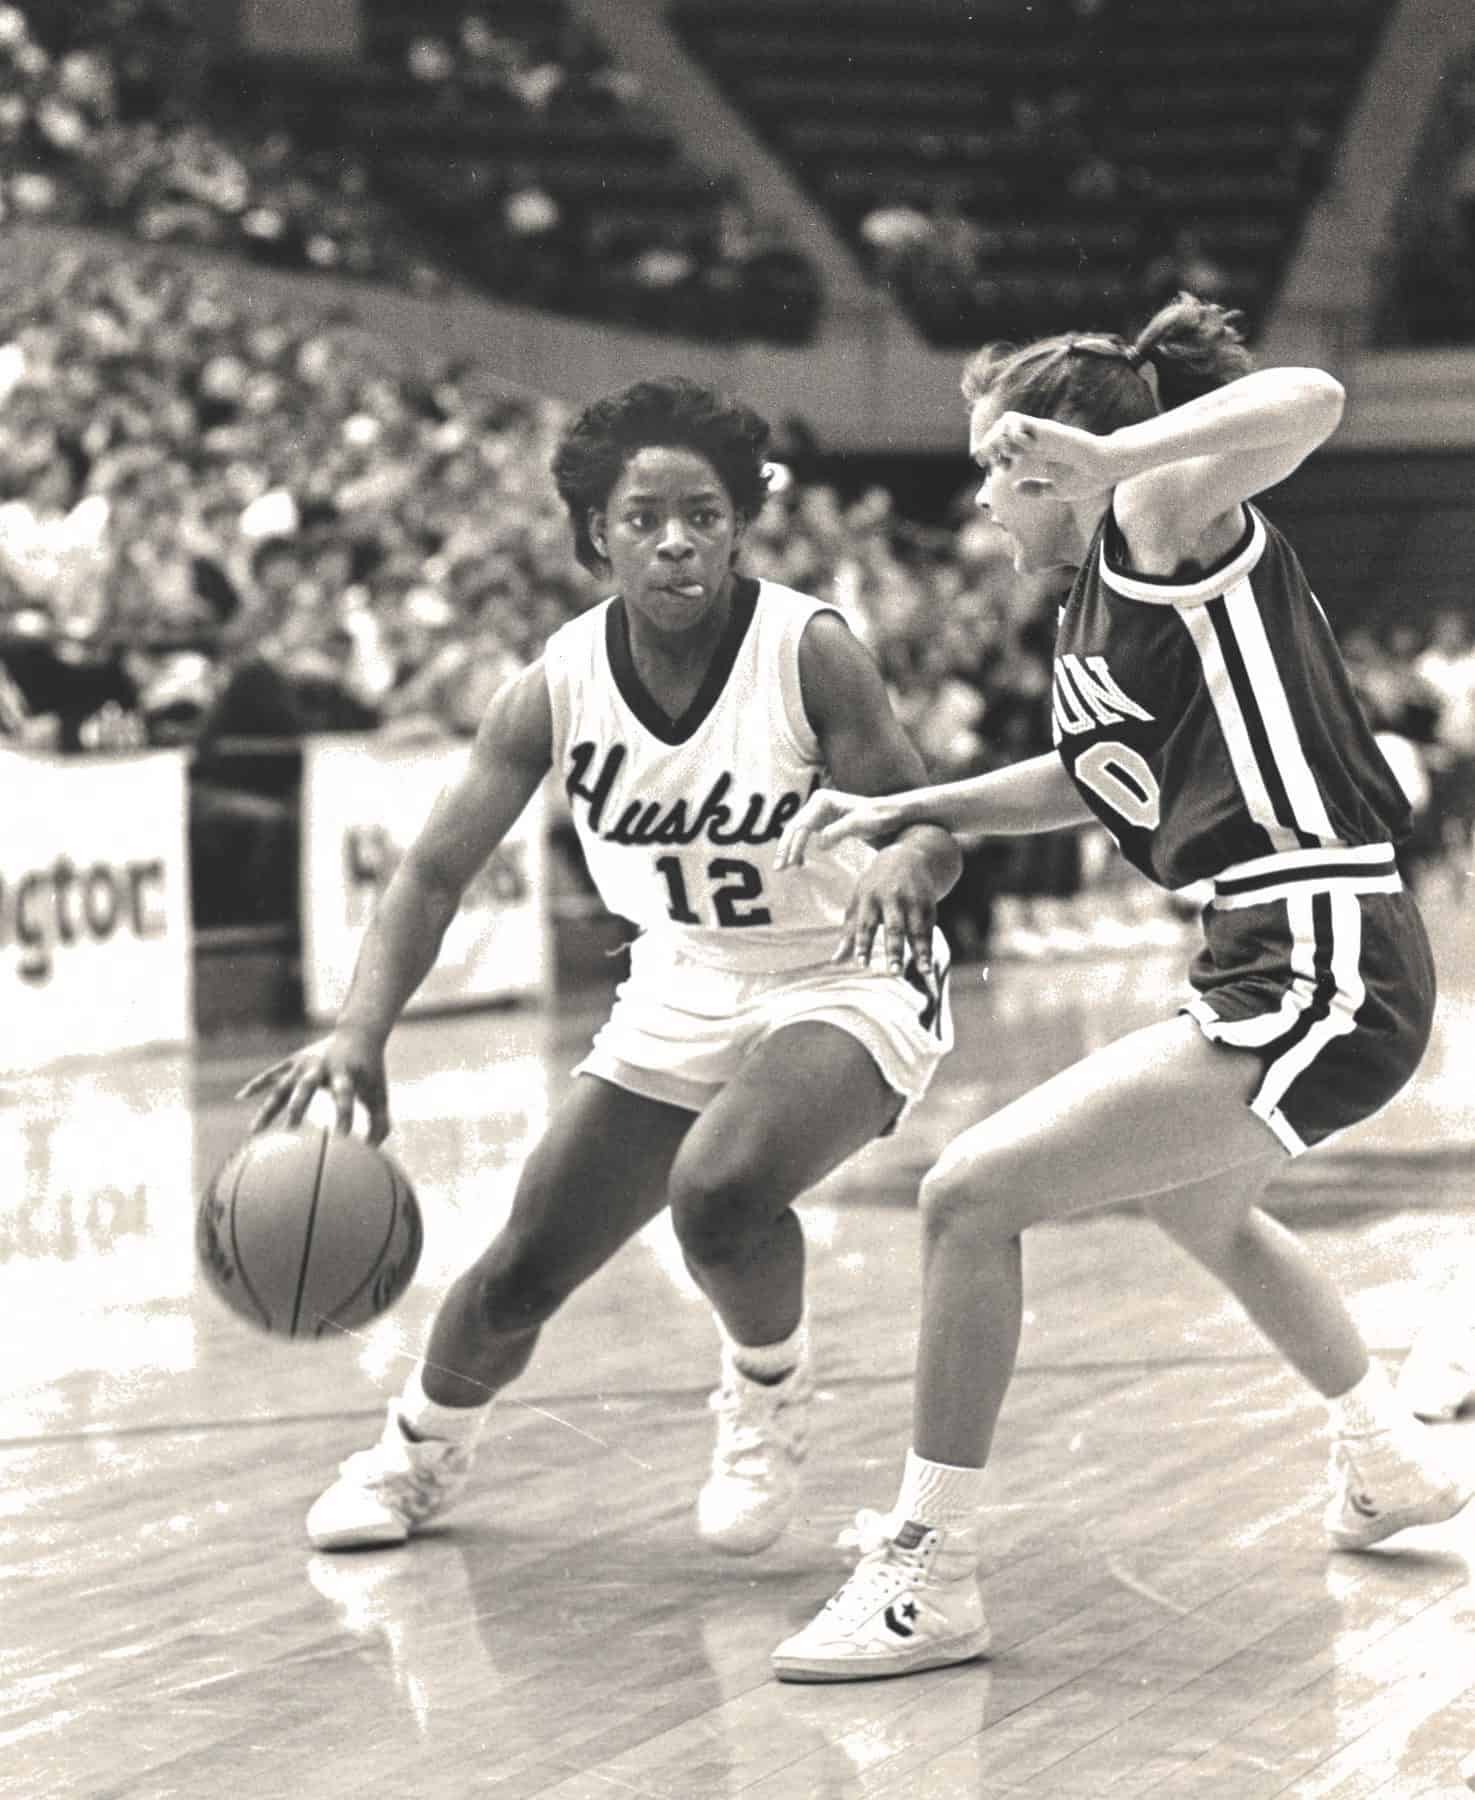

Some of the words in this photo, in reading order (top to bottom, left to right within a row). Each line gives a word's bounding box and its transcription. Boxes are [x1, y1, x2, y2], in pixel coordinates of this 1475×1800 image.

[566, 741, 820, 845] Huskie
[1075, 741, 1161, 831] 0
[656, 855, 773, 928] 12
